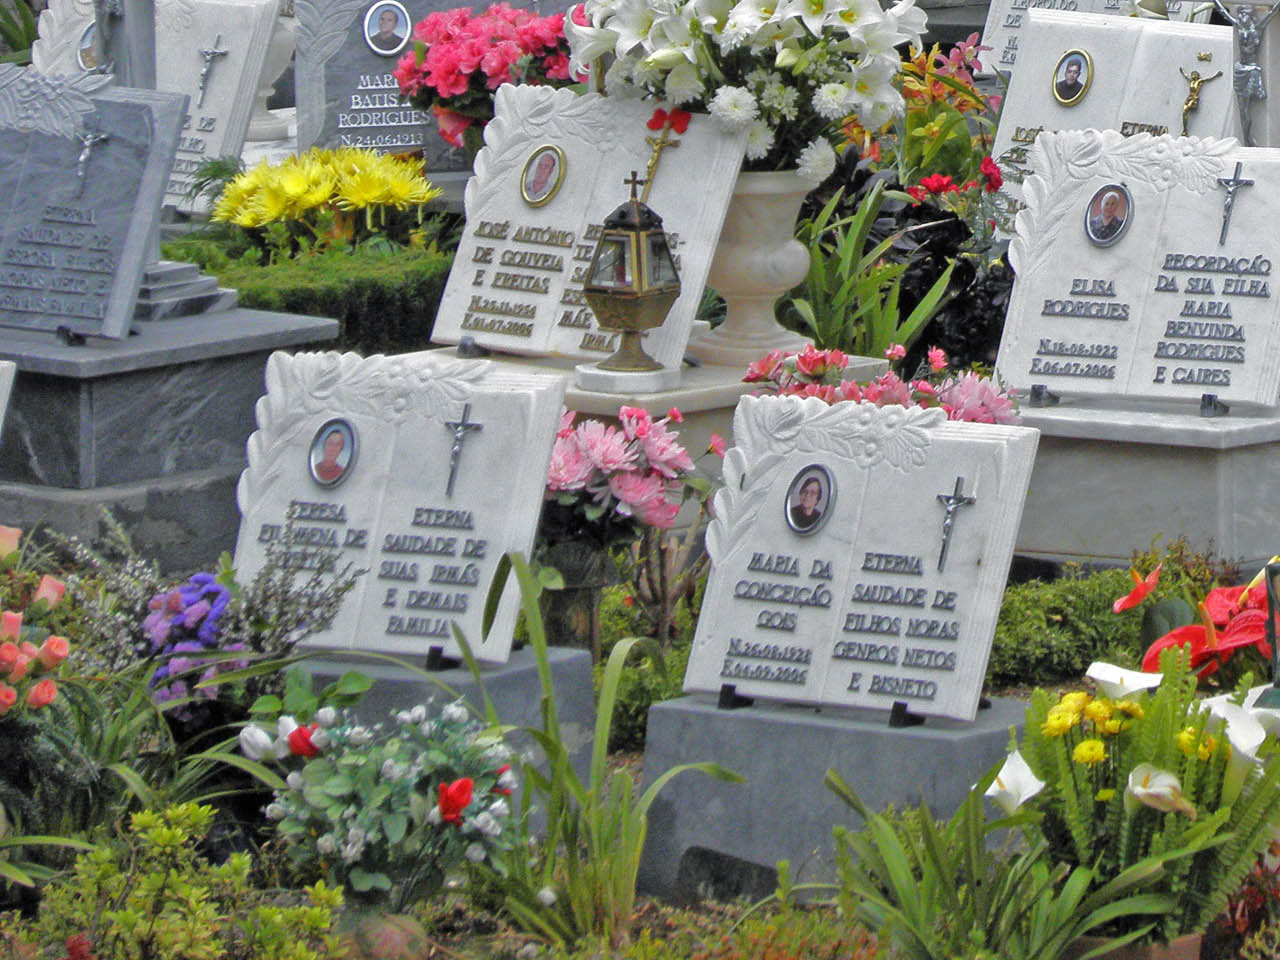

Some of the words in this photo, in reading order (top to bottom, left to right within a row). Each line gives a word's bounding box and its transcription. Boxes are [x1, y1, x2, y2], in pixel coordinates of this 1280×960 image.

[338, 110, 430, 128] RODRIGUES
[473, 220, 510, 240] JOSÉ
[511, 225, 575, 248] ANTÓNIO
[471, 246, 494, 264] DE
[499, 250, 564, 272] GOUVEIA
[471, 269, 485, 286] E
[491, 272, 550, 294] FREITAS
[1069, 278, 1117, 298] ELISA
[1154, 275, 1179, 293] DA
[1184, 277, 1215, 295] SUA
[1221, 278, 1271, 298] FILHA
[1041, 299, 1130, 321] RODRIGUES
[1180, 300, 1233, 319] MARIA
[1164, 320, 1246, 342] BENVINDA
[1153, 341, 1245, 364] RODRIGUES
[1153, 366, 1165, 384] E
[1171, 368, 1232, 386] CAIRES
[411, 506, 474, 530] ETERNA
[342, 529, 368, 550] DE
[381, 534, 456, 558] SAUDADE
[462, 539, 488, 559] DE
[378, 561, 419, 582] SUAS
[748, 552, 800, 577] MARIA
[809, 559, 833, 580] DA
[861, 552, 924, 576] ETERNA
[382, 589, 395, 608] E
[405, 589, 468, 613] DEMAIS
[851, 584, 927, 609] SAUDADE
[931, 590, 958, 611] DE
[385, 615, 451, 638] FAMILIA
[842, 613, 901, 636] FILHOS
[904, 618, 960, 641] NORAS
[831, 641, 899, 665] GENROS
[902, 648, 957, 671] NETOS
[847, 673, 862, 691] E
[868, 675, 938, 700] BISNETO
